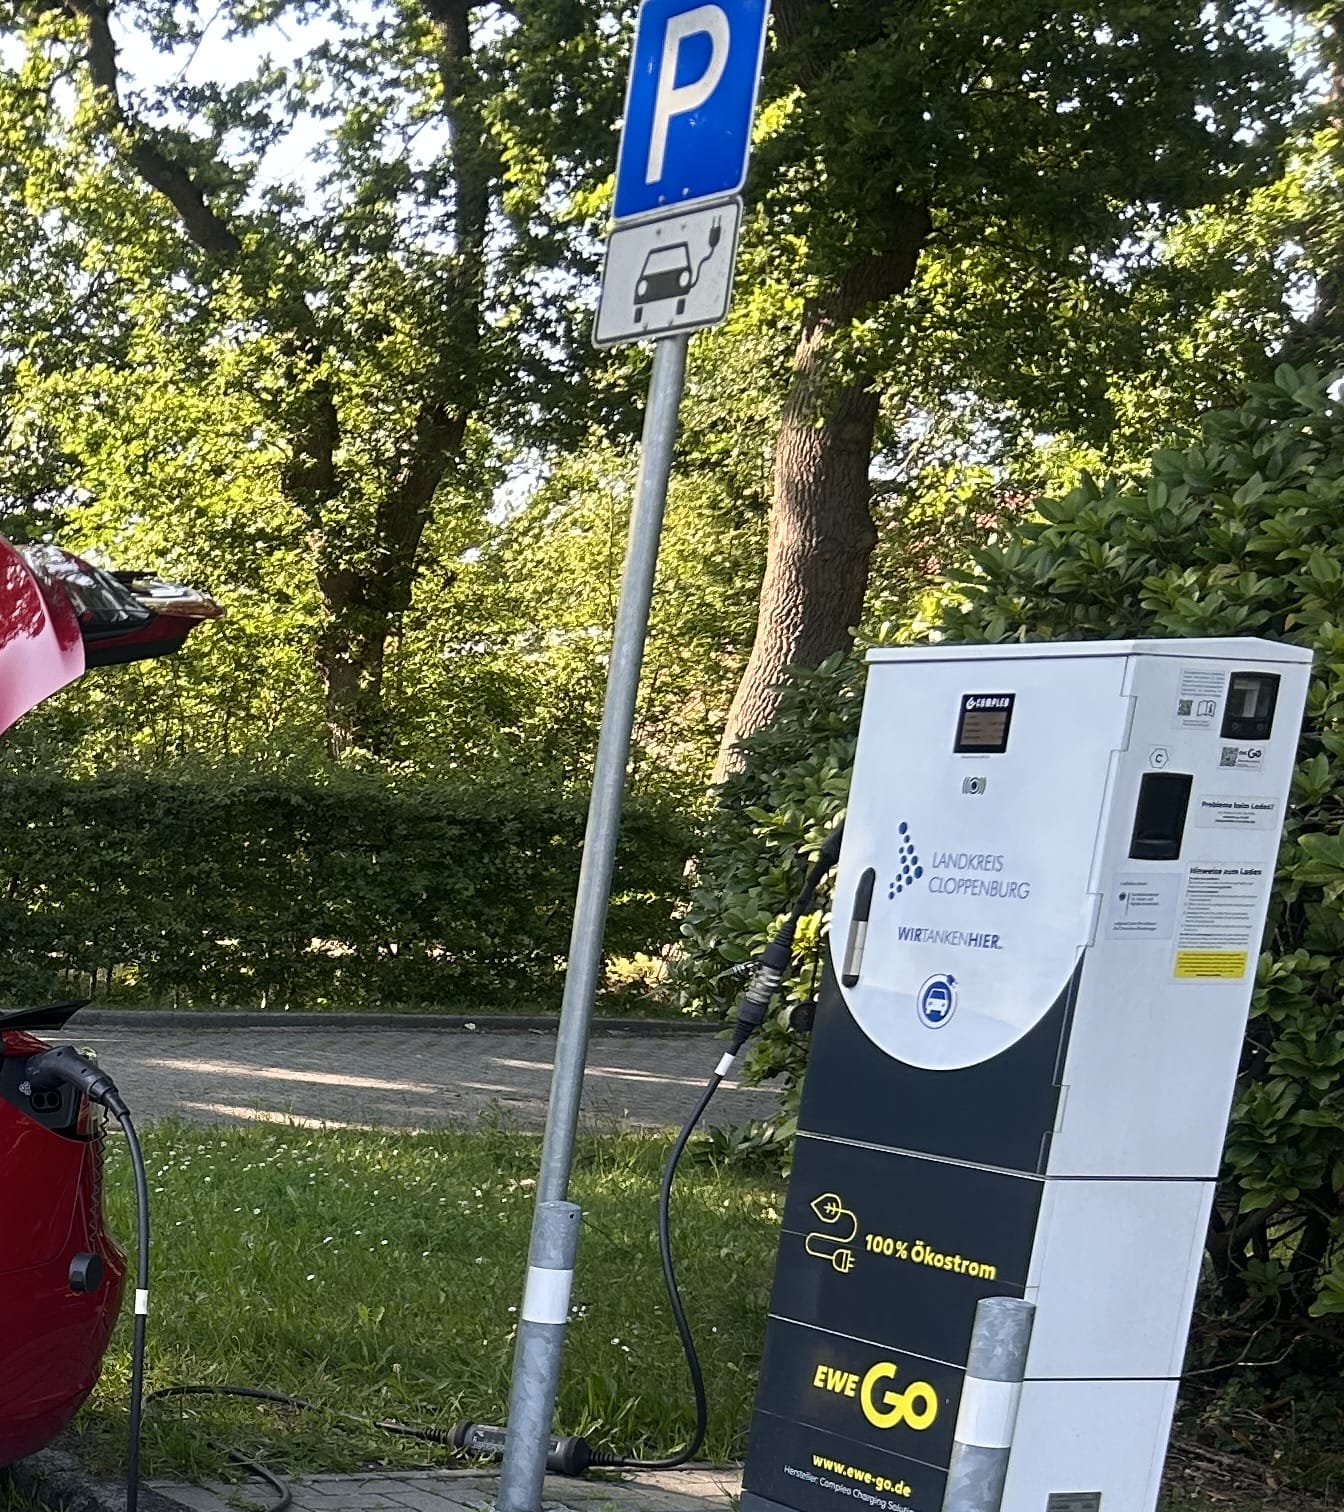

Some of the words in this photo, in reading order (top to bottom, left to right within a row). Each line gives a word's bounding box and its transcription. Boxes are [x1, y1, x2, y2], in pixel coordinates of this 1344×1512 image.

[645, 4, 730, 185] P
[932, 852, 1004, 872] LANDKREIS
[928, 876, 1031, 900] CLOPPENBURG
[910, 1240, 997, 1281] Ökostrom
[813, 1364, 860, 1398] EWE
[812, 1454, 912, 1498] www.ewe-go.de
[819, 1476, 852, 1497] Compleo
[852, 1488, 887, 1511] Charging
